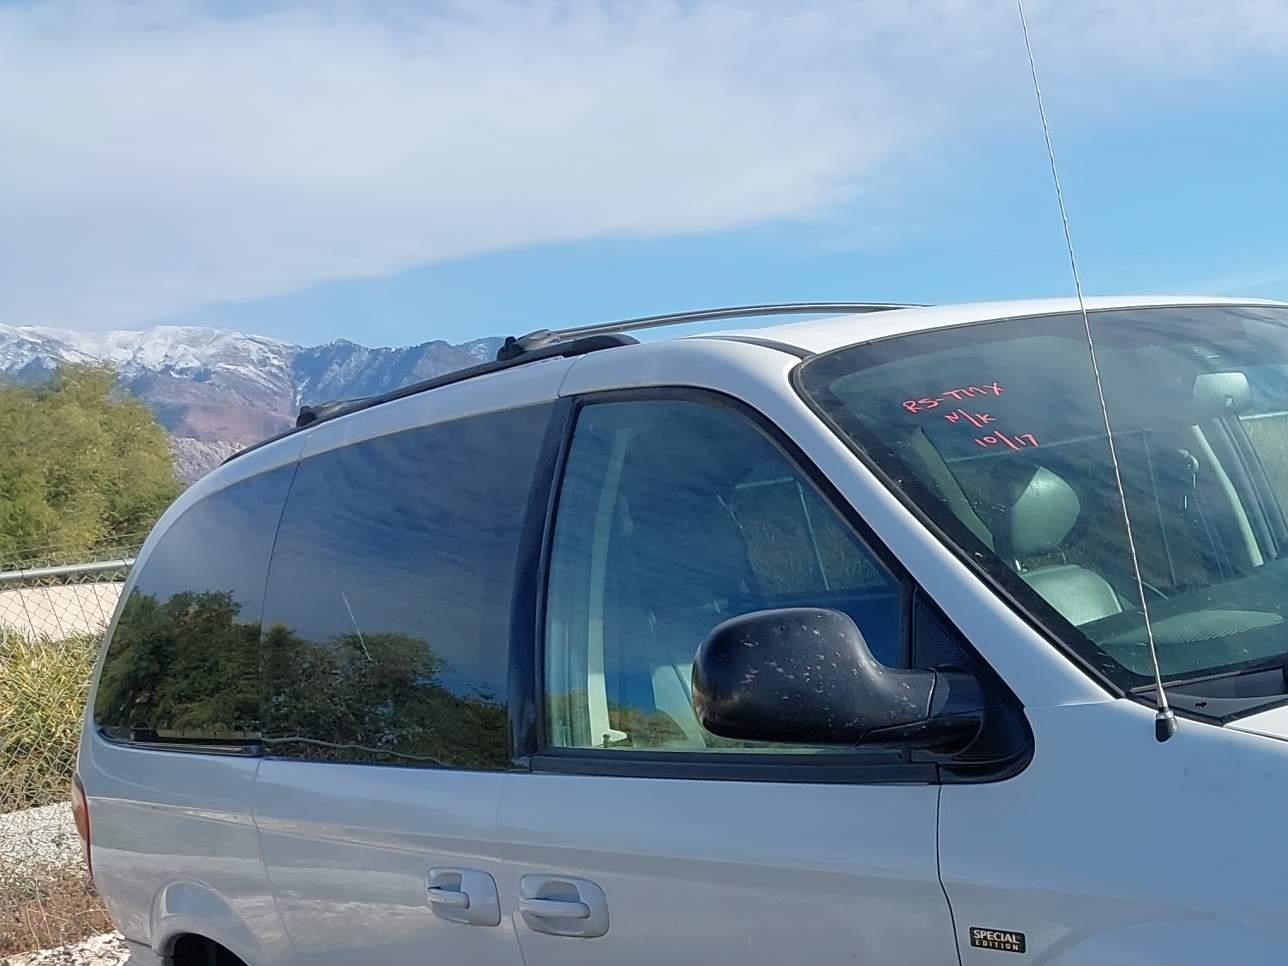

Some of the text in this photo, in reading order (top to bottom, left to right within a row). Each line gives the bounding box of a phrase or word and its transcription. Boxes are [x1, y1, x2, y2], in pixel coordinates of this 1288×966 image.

[974, 431, 1040, 451] 10/17
[973, 929, 1020, 943] SPECIAL
[975, 939, 1019, 951] EDITION
